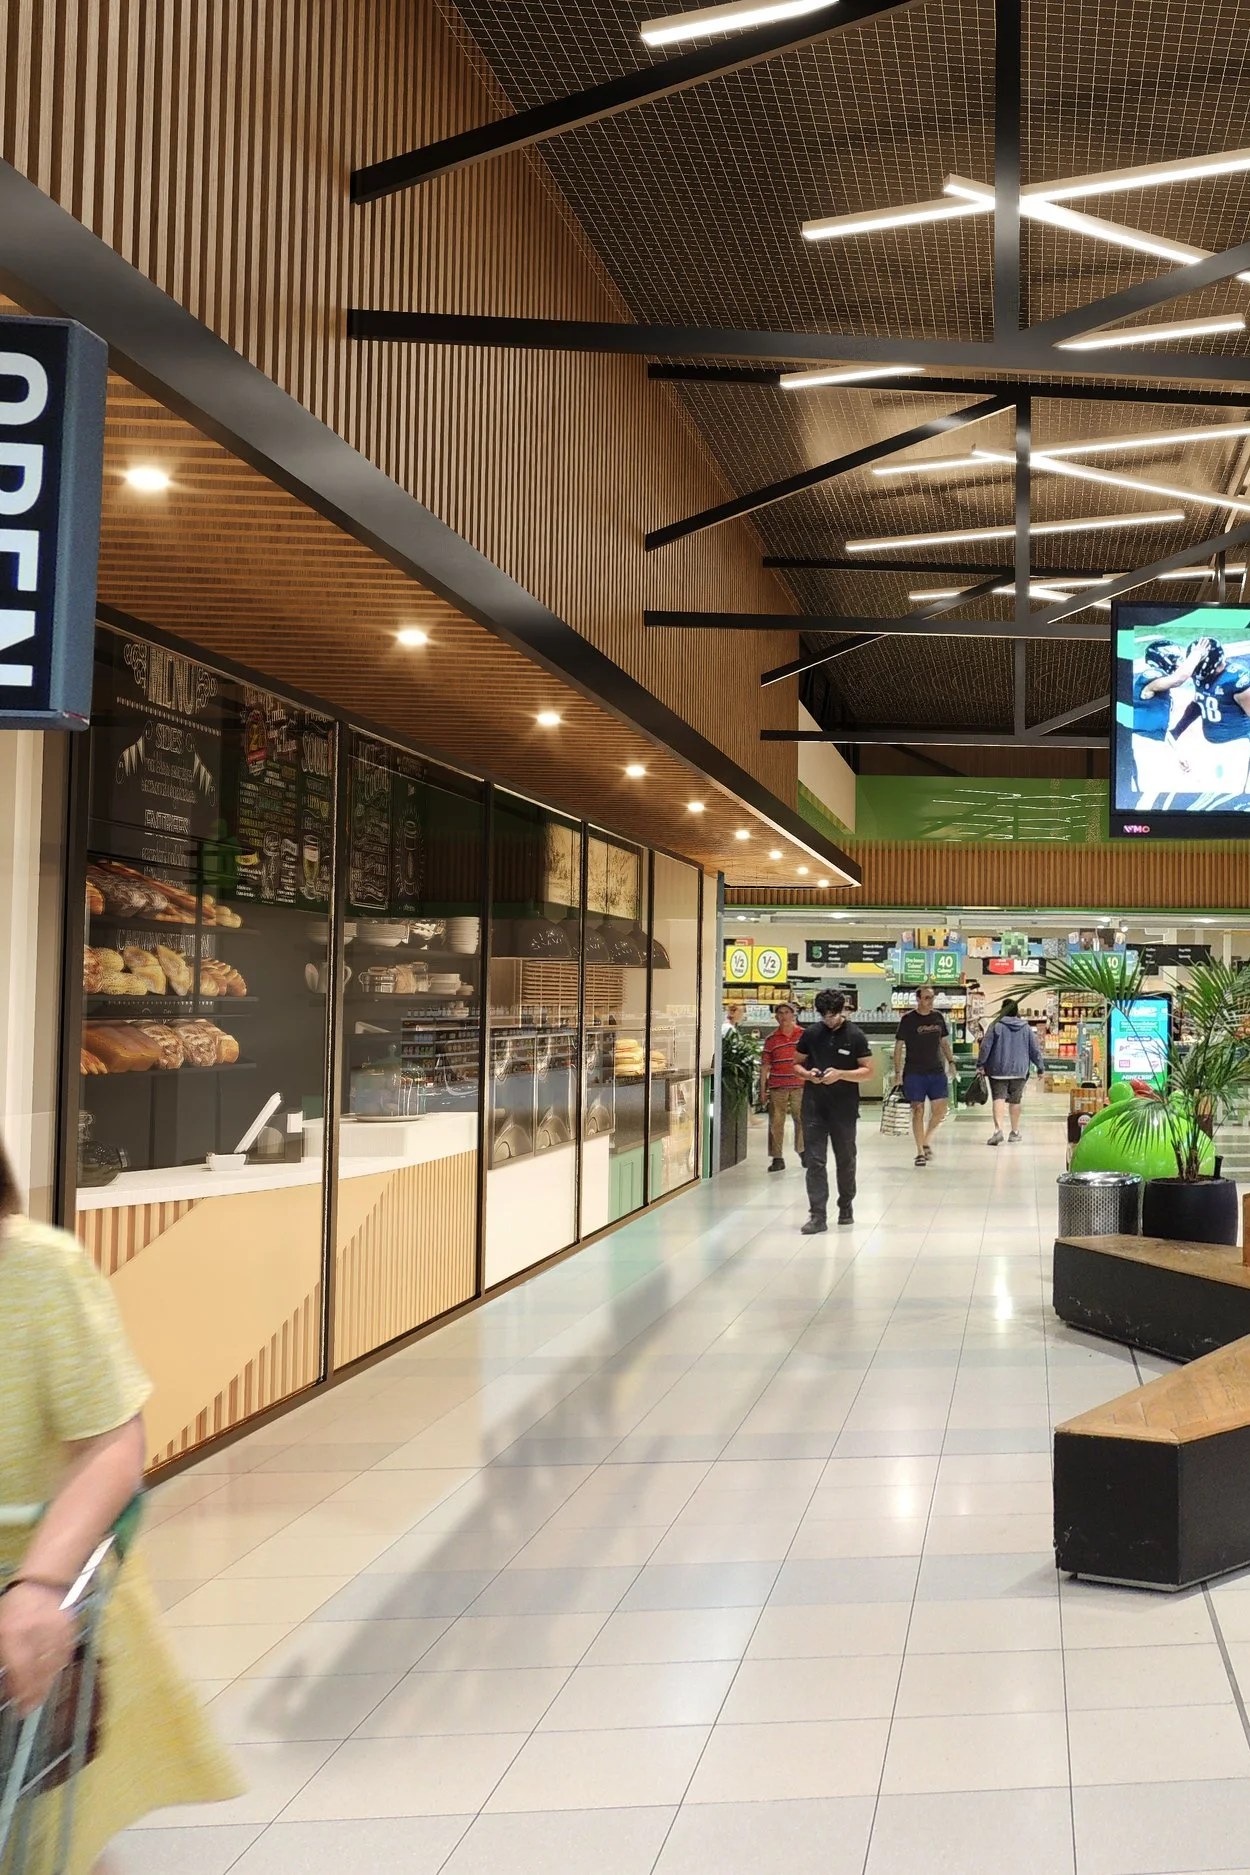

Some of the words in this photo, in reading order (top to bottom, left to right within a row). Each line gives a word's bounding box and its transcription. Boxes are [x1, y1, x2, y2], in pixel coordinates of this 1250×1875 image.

[734, 955, 745, 967] 1/2
[762, 955, 776, 968] 1/2
[938, 955, 953, 967] 40
